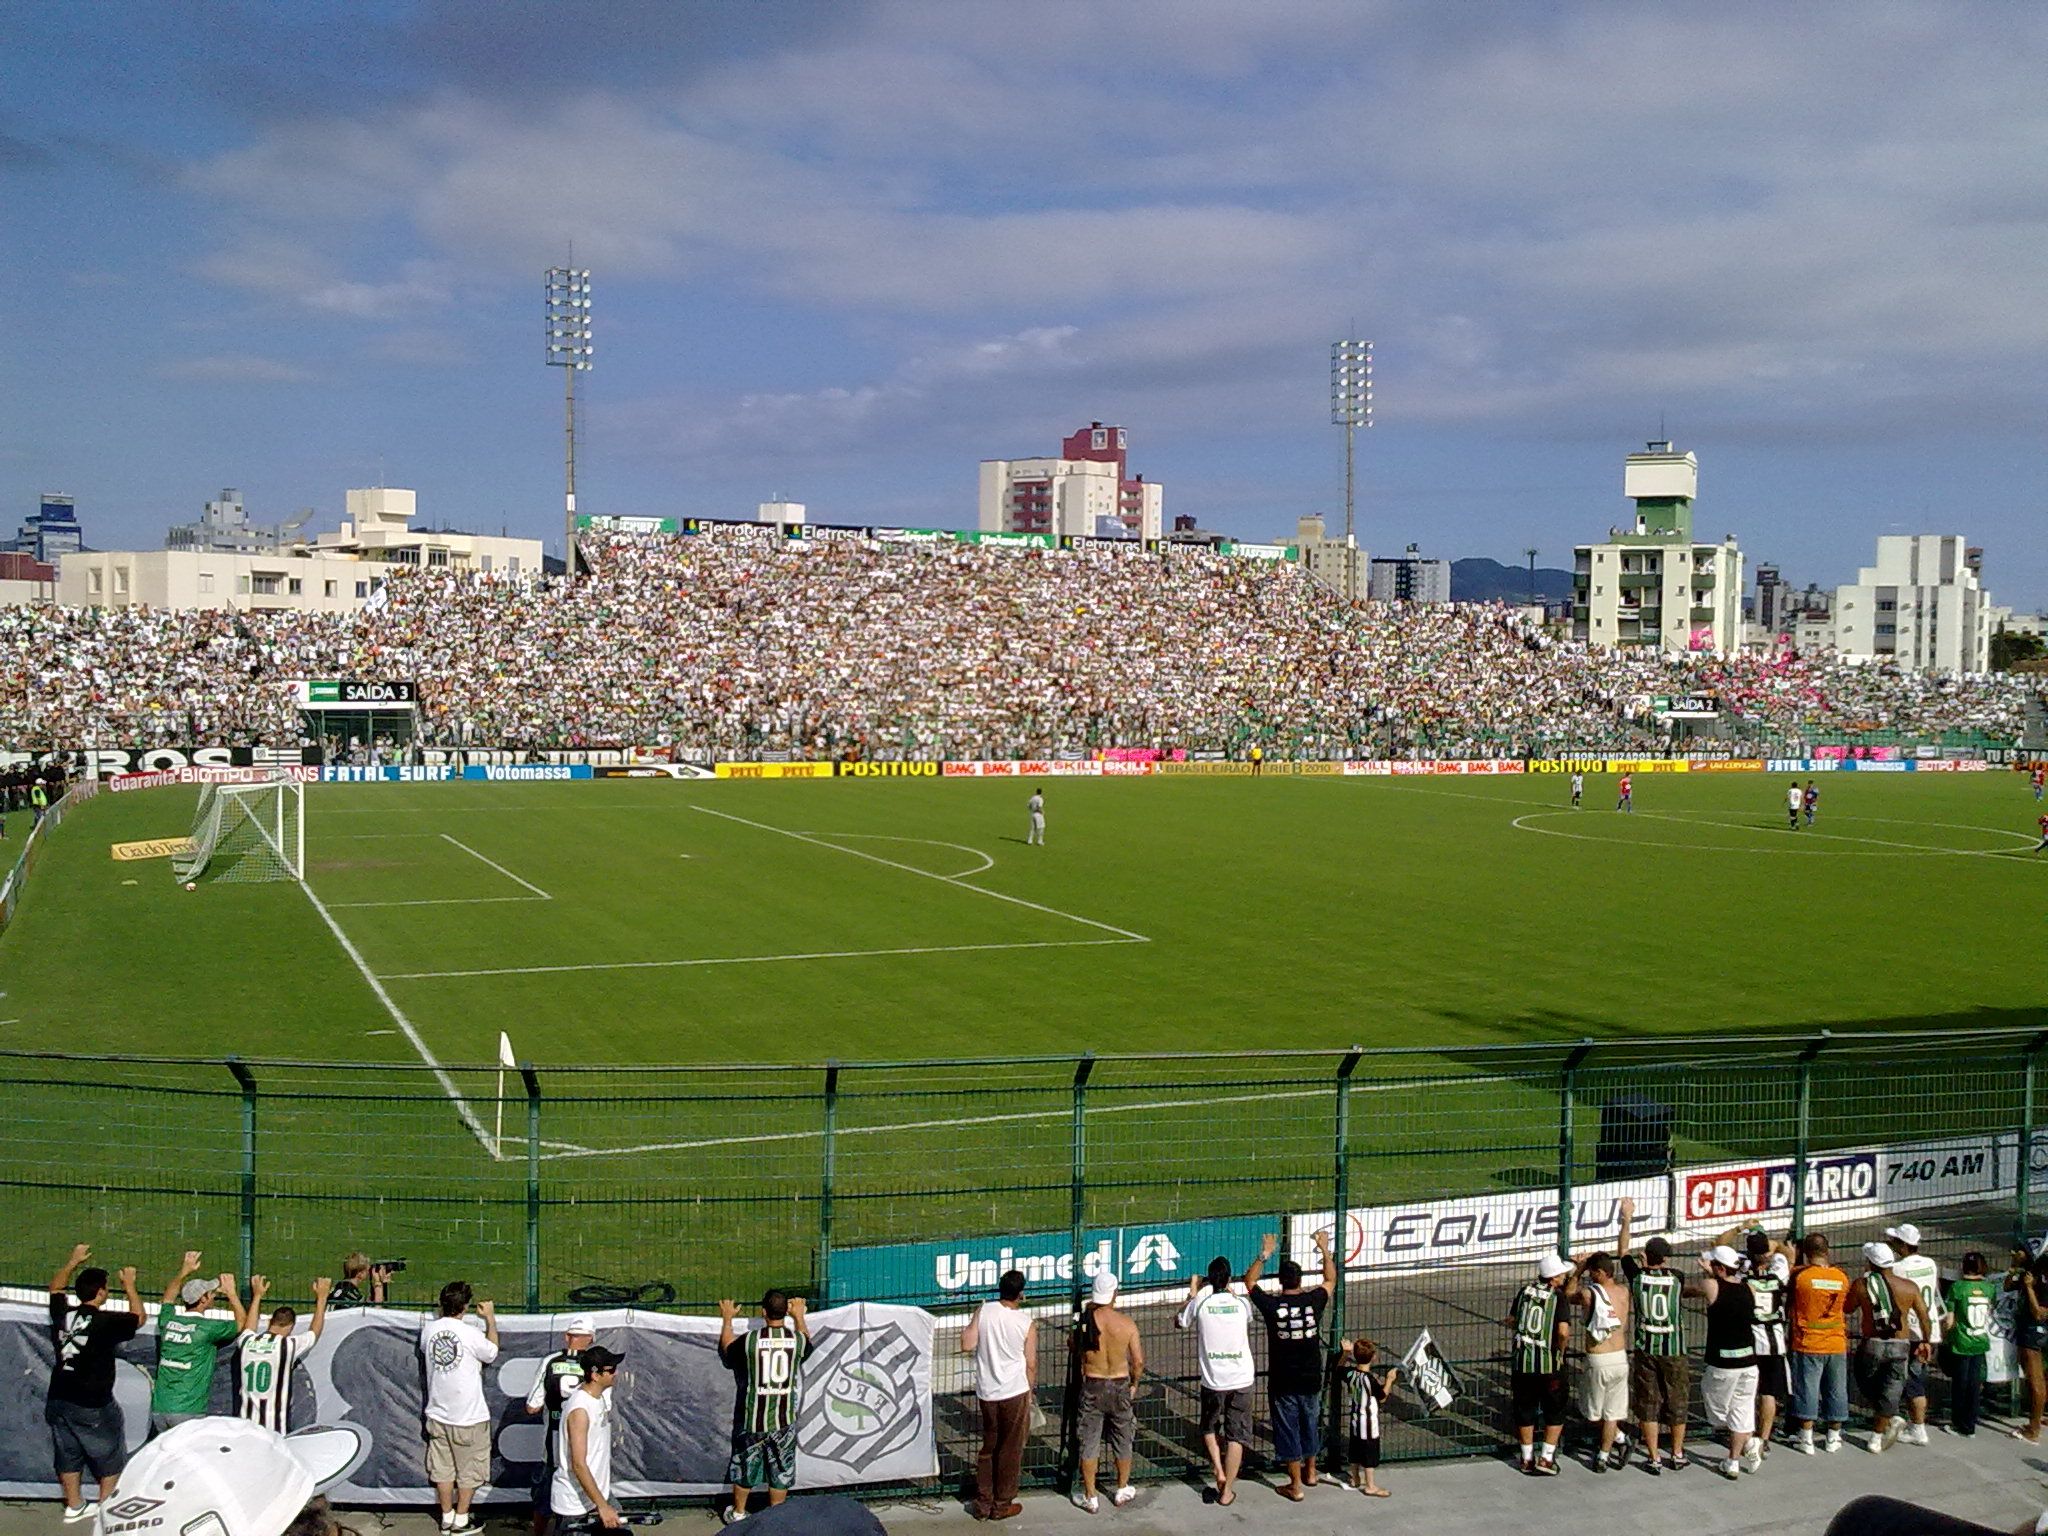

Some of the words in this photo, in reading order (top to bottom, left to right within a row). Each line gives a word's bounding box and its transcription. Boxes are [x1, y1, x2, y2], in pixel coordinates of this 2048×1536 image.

[699, 520, 776, 538] Eletrobras
[346, 682, 396, 700] SAÍDA
[400, 685, 409, 700] 3
[1706, 699, 1714, 711] 2
[181, 766, 253, 783] BIOTIPO
[324, 766, 391, 782] FATAL
[399, 766, 452, 781] SURF
[485, 765, 572, 781] Votomassa
[839, 761, 938, 777] POSITIVO
[1054, 761, 1098, 770] SKILL
[1103, 761, 1150, 771] SKILL
[1528, 759, 1602, 773] POSITIVO
[109, 769, 176, 792] Guaravita
[1886, 1158, 1936, 1185] 740
[1939, 1152, 1985, 1179] AM
[1690, 1176, 1760, 1218] CBN
[1769, 1159, 1873, 1208] DÁRIO
[1383, 1197, 1651, 1253] EQUISUL
[935, 1239, 1112, 1290] Unimed
[164, 1331, 193, 1345] FILA
[761, 1350, 789, 1384] 10
[243, 1360, 272, 1393] 10
[105, 1517, 164, 1535] UMBRO
